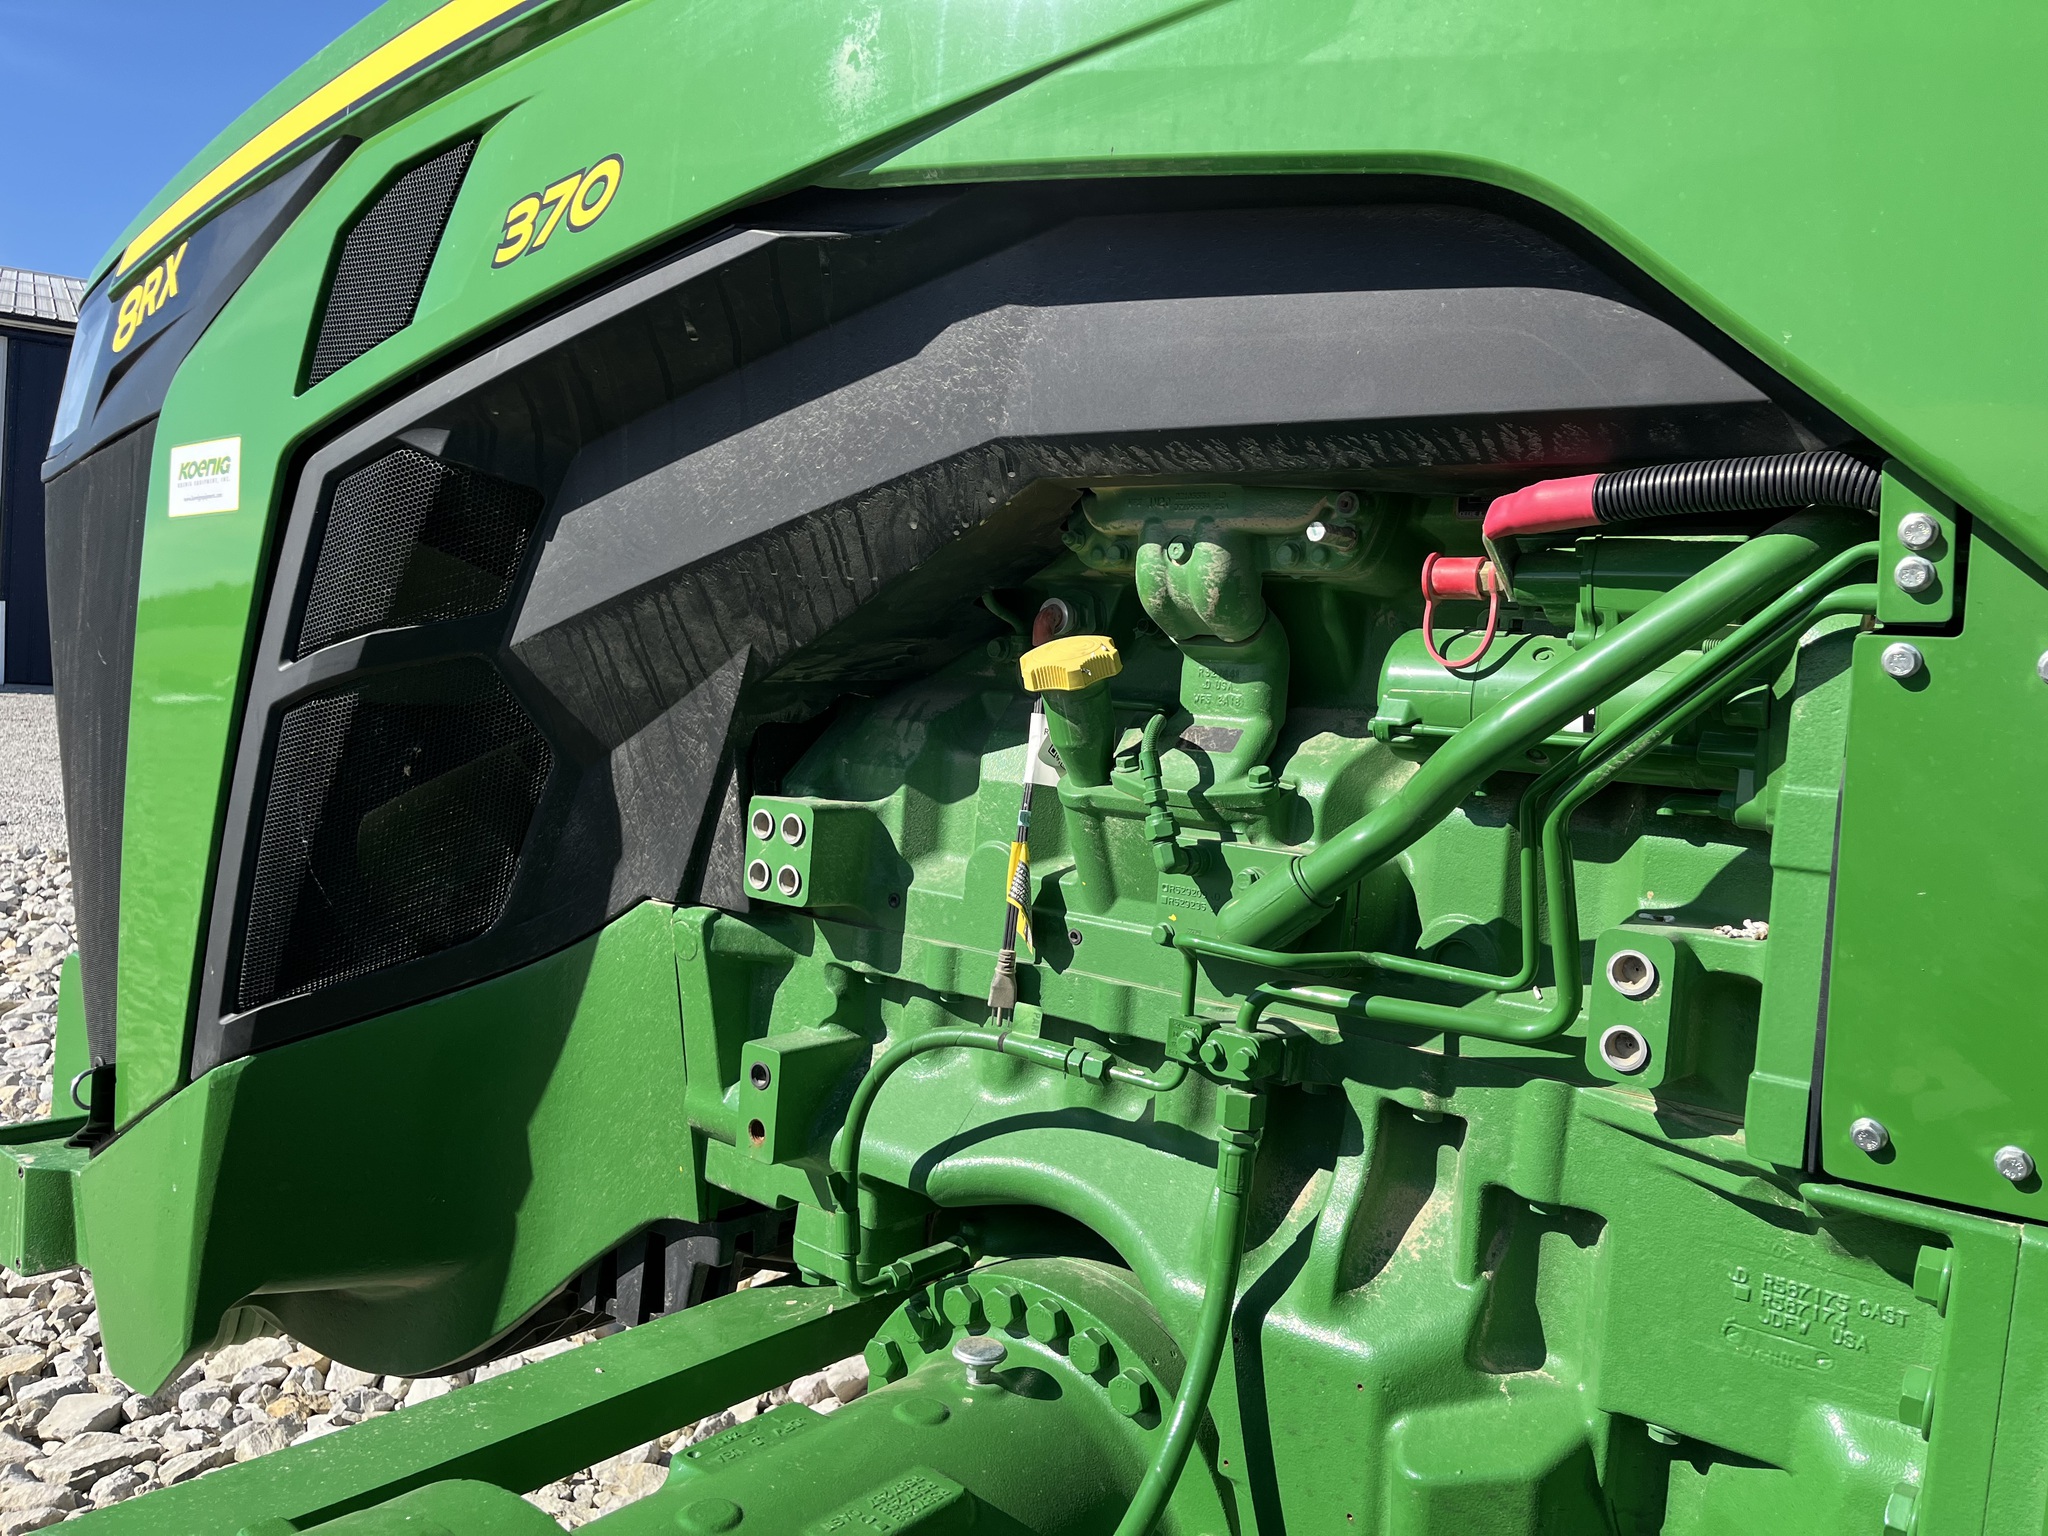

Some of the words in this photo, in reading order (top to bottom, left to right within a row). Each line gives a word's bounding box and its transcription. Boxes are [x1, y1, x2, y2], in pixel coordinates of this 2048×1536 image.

[491, 153, 624, 269] 370
[112, 241, 188, 353] 8RX
[1168, 896, 1207, 912] R529235
[1858, 1299, 1910, 1328] CAST
[1832, 1326, 1870, 1354] USA
